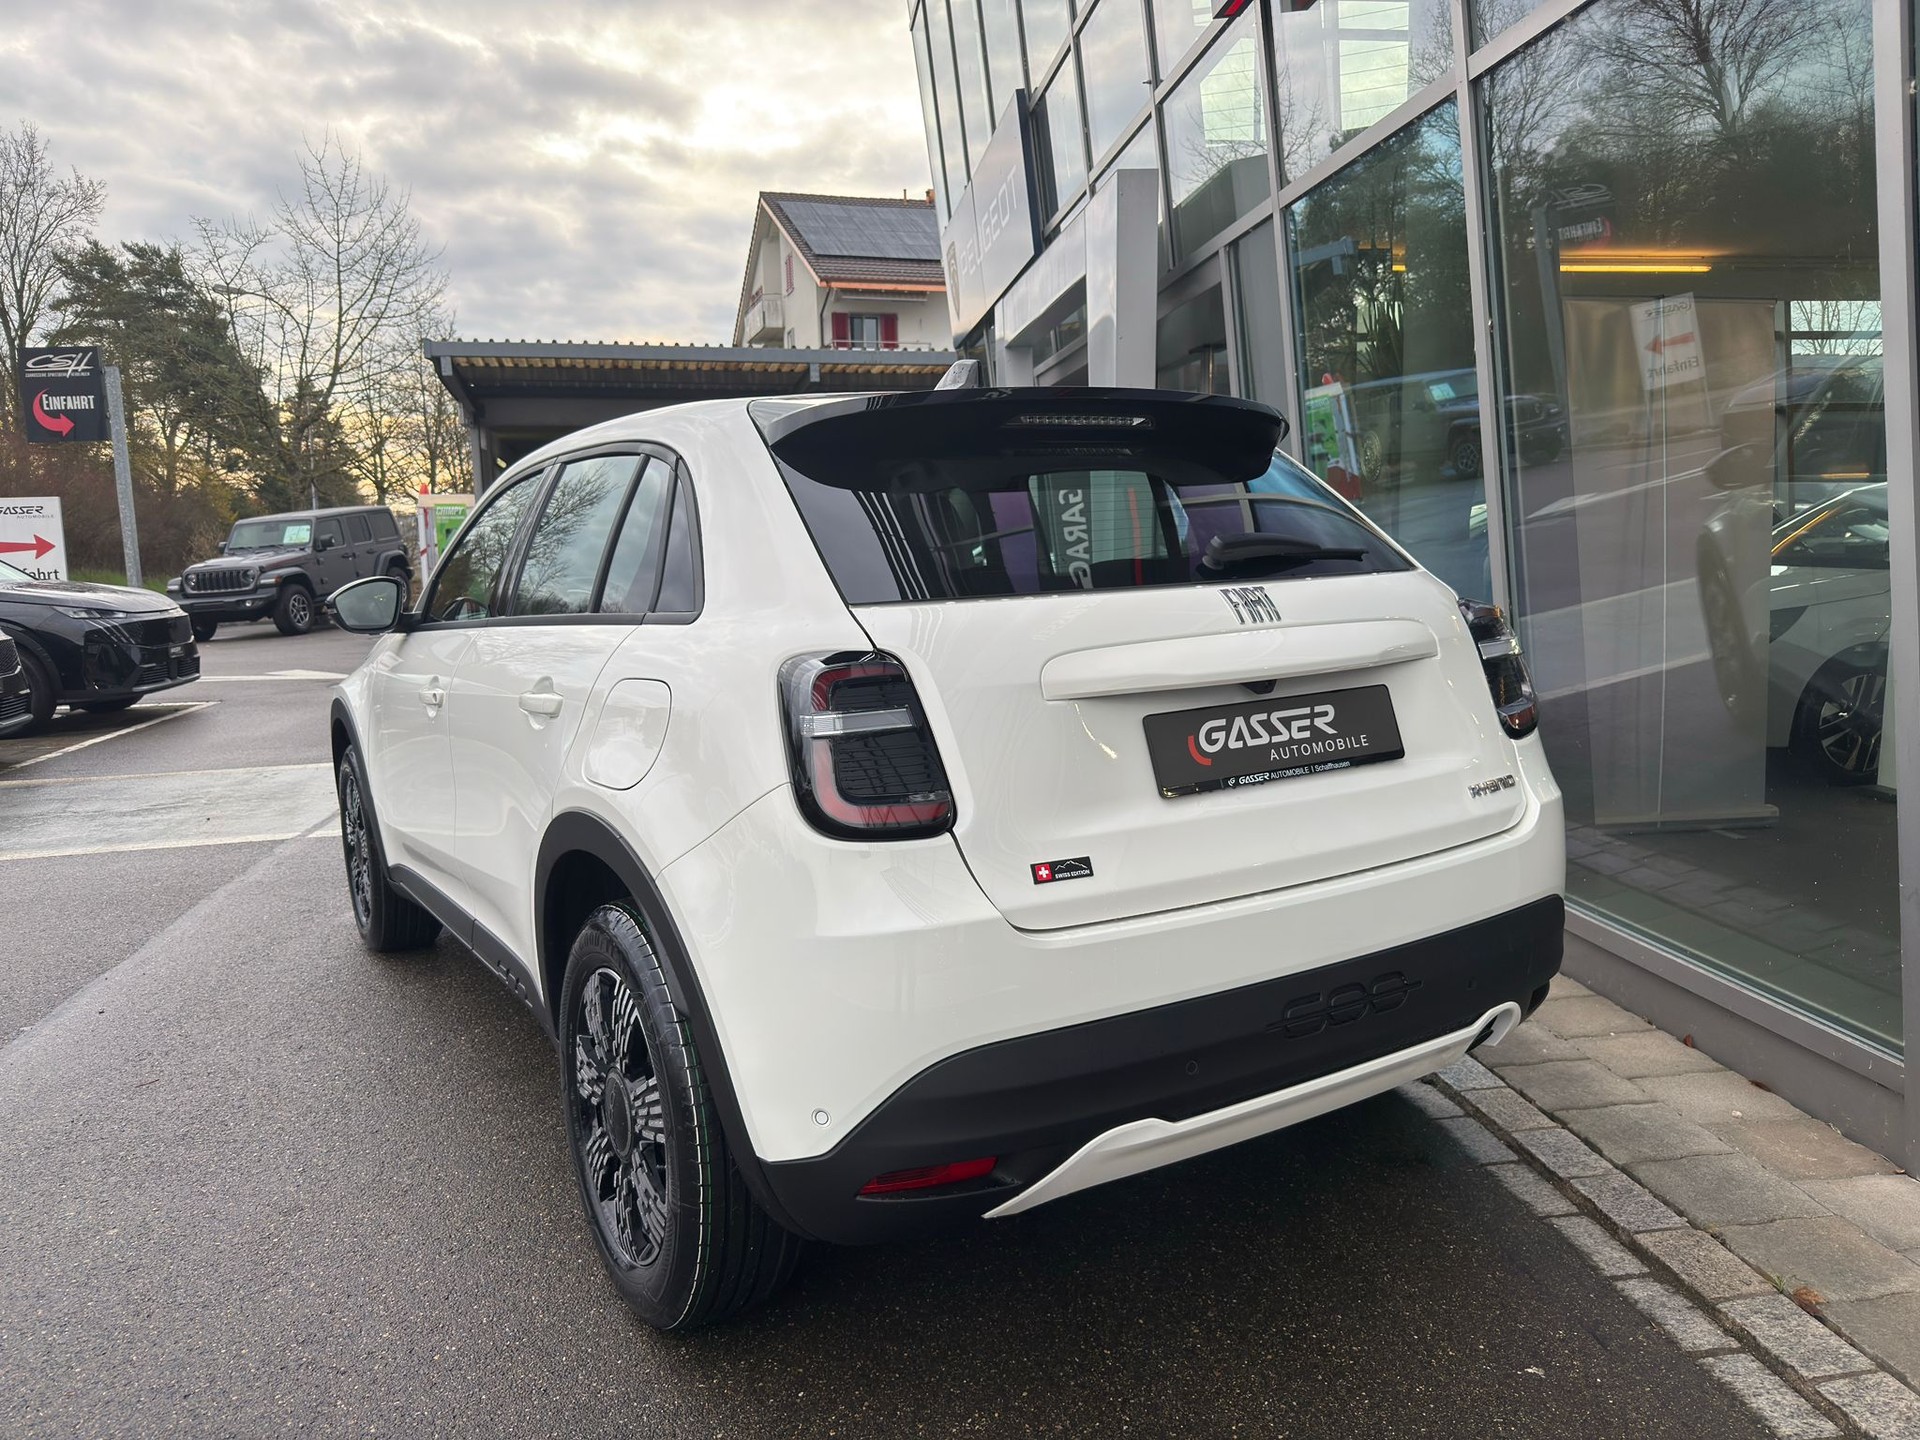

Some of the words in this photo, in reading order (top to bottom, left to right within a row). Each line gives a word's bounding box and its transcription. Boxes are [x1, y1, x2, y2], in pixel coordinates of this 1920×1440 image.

[960, 164, 1017, 275] PEUGEOT
[42, 394, 95, 410] EINFAHRT
[1217, 586, 1282, 625] FIAT
[1198, 704, 1338, 753] GASSER
[1270, 734, 1369, 761] AUTOMOBILE
[1238, 772, 1270, 785] GASSER
[1270, 766, 1310, 779] AUTOMOBILE
[1314, 760, 1351, 772] Schaffhausen
[1071, 869, 1090, 877] EDITION
